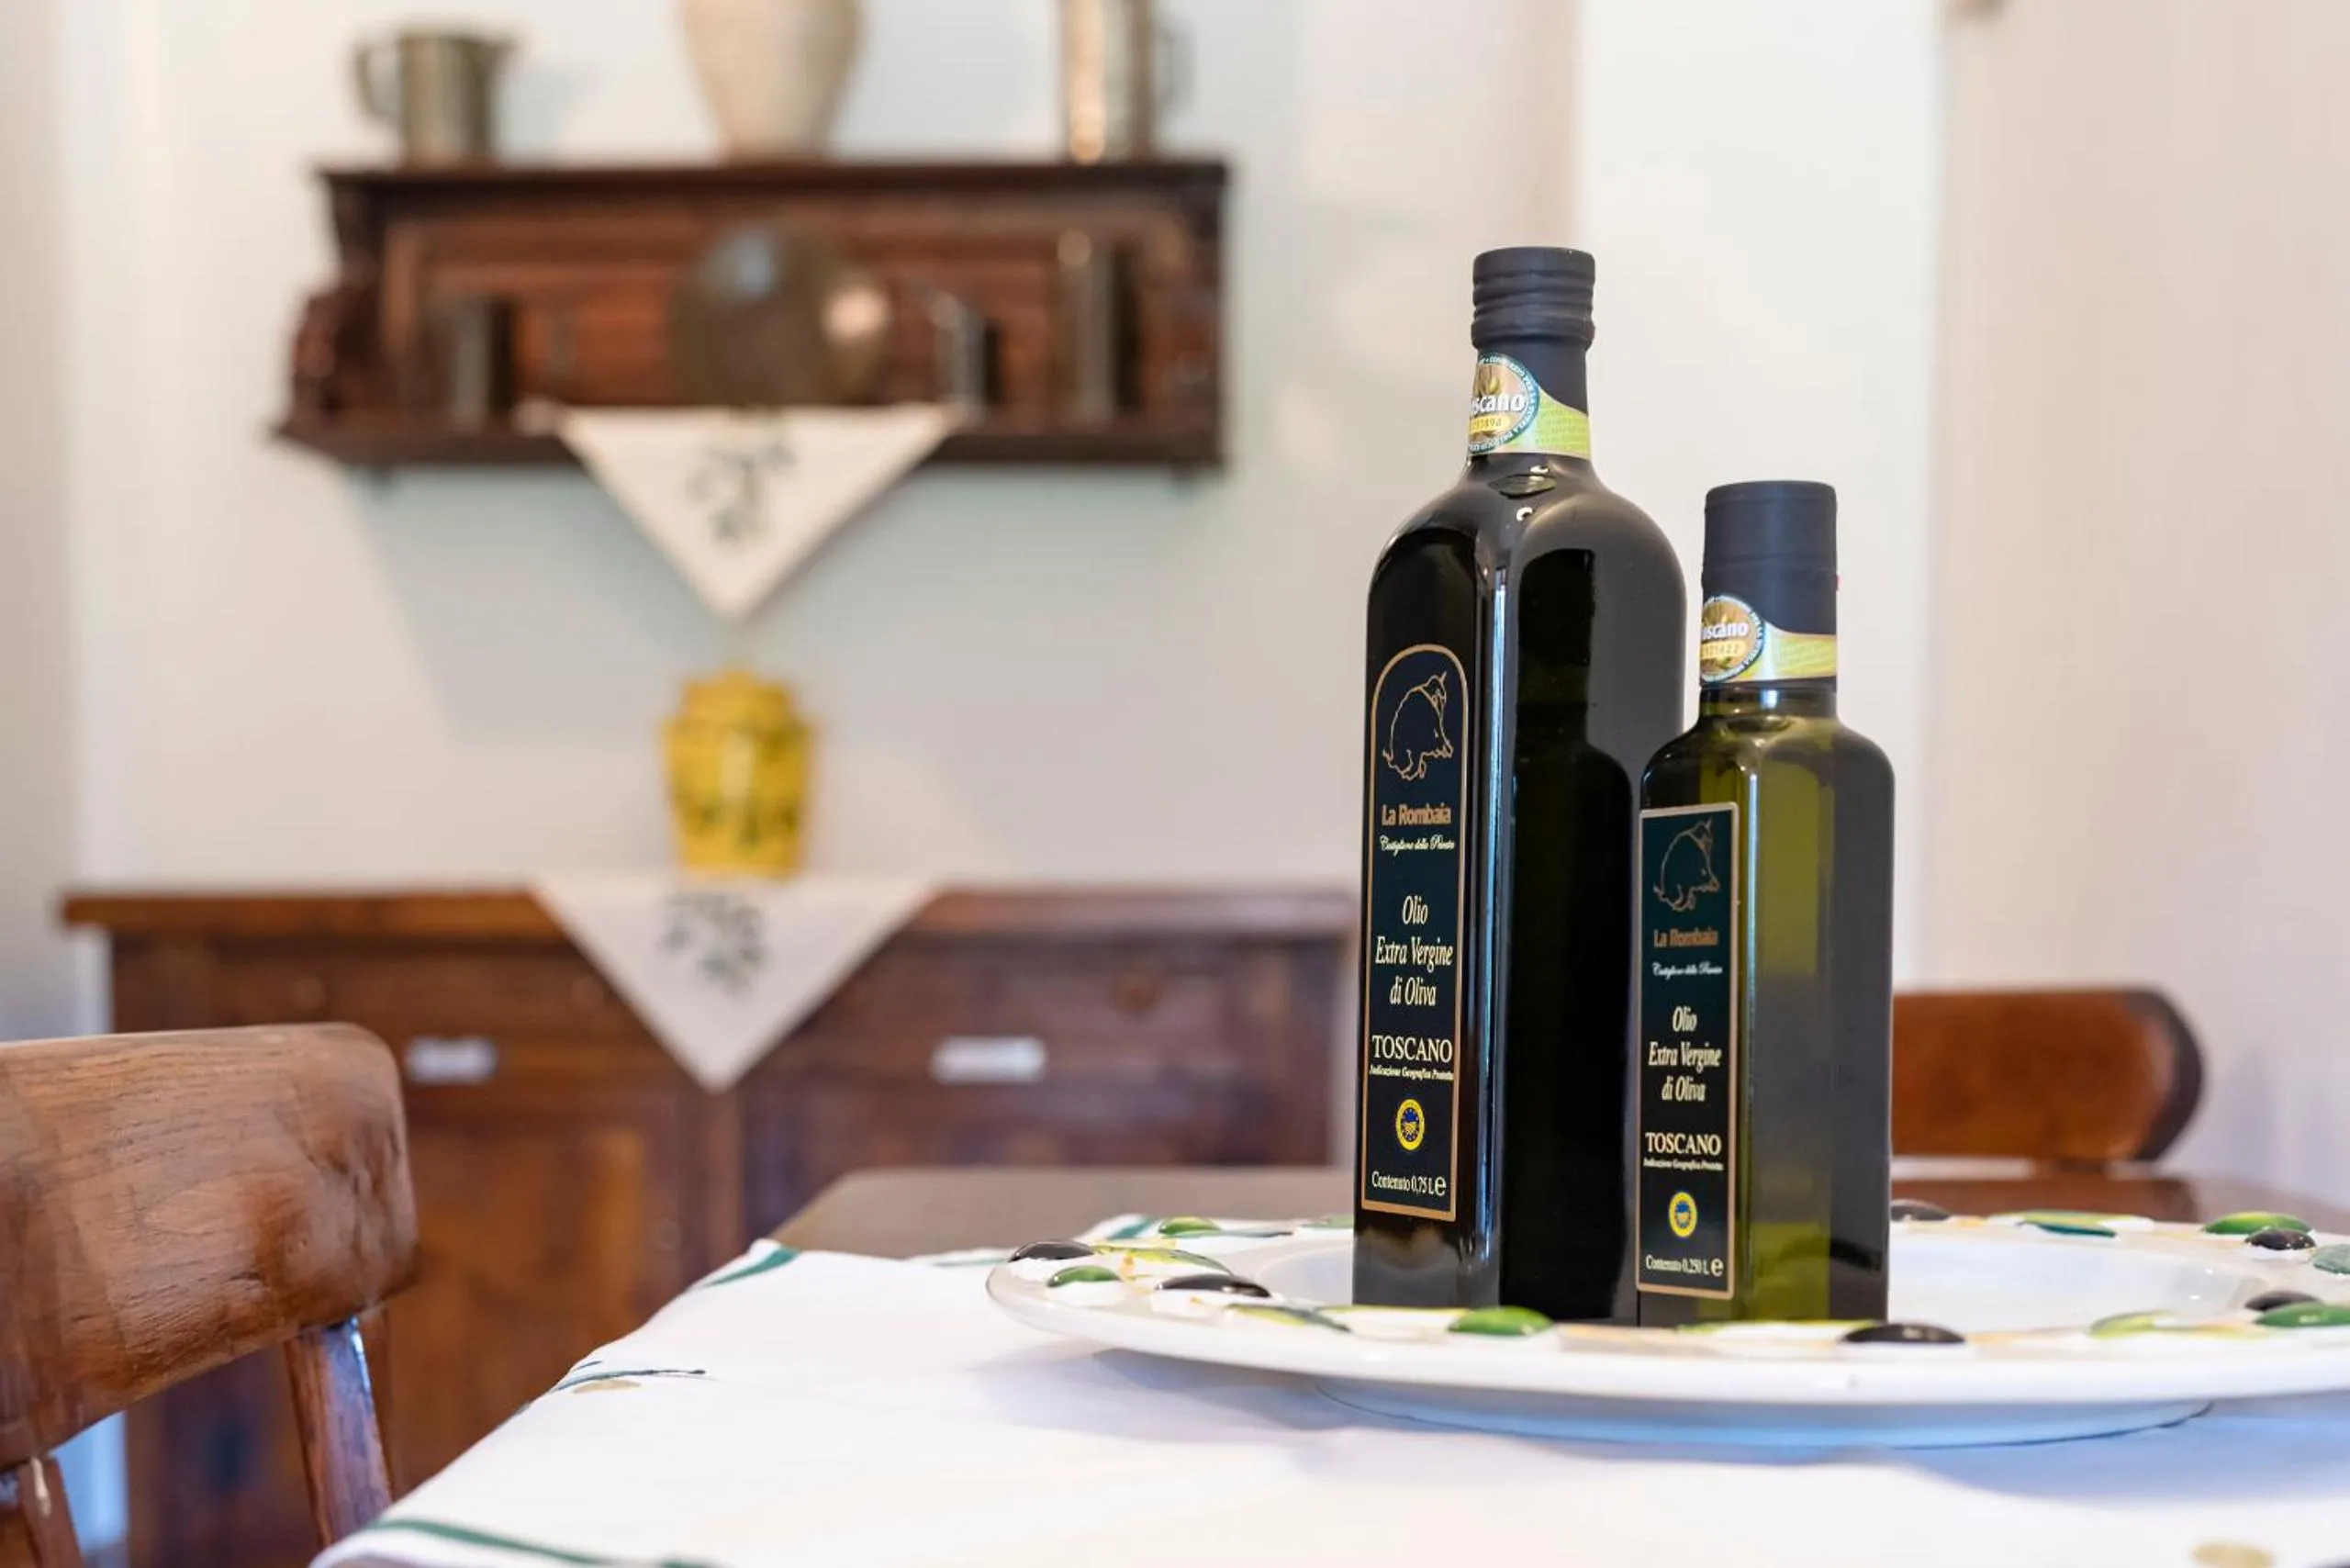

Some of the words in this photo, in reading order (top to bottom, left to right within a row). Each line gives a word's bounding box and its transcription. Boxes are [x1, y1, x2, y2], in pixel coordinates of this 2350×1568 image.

[1382, 804, 1395, 825] La
[1398, 801, 1452, 825] Rombaia
[1402, 895, 1428, 924] Olio
[1375, 935, 1408, 965] Extra
[1411, 935, 1453, 973] Vergine
[1389, 975, 1403, 1005] di
[1404, 976, 1437, 1006] Oliva
[1673, 1005, 1697, 1032] Olio
[1371, 1035, 1453, 1063] TOSCANO
[1648, 1041, 1679, 1066] Extra
[1681, 1041, 1722, 1074] Vergine
[1662, 1075, 1674, 1101] di
[1675, 1075, 1707, 1102] Oliva
[1644, 1132, 1722, 1156] TOSCANO
